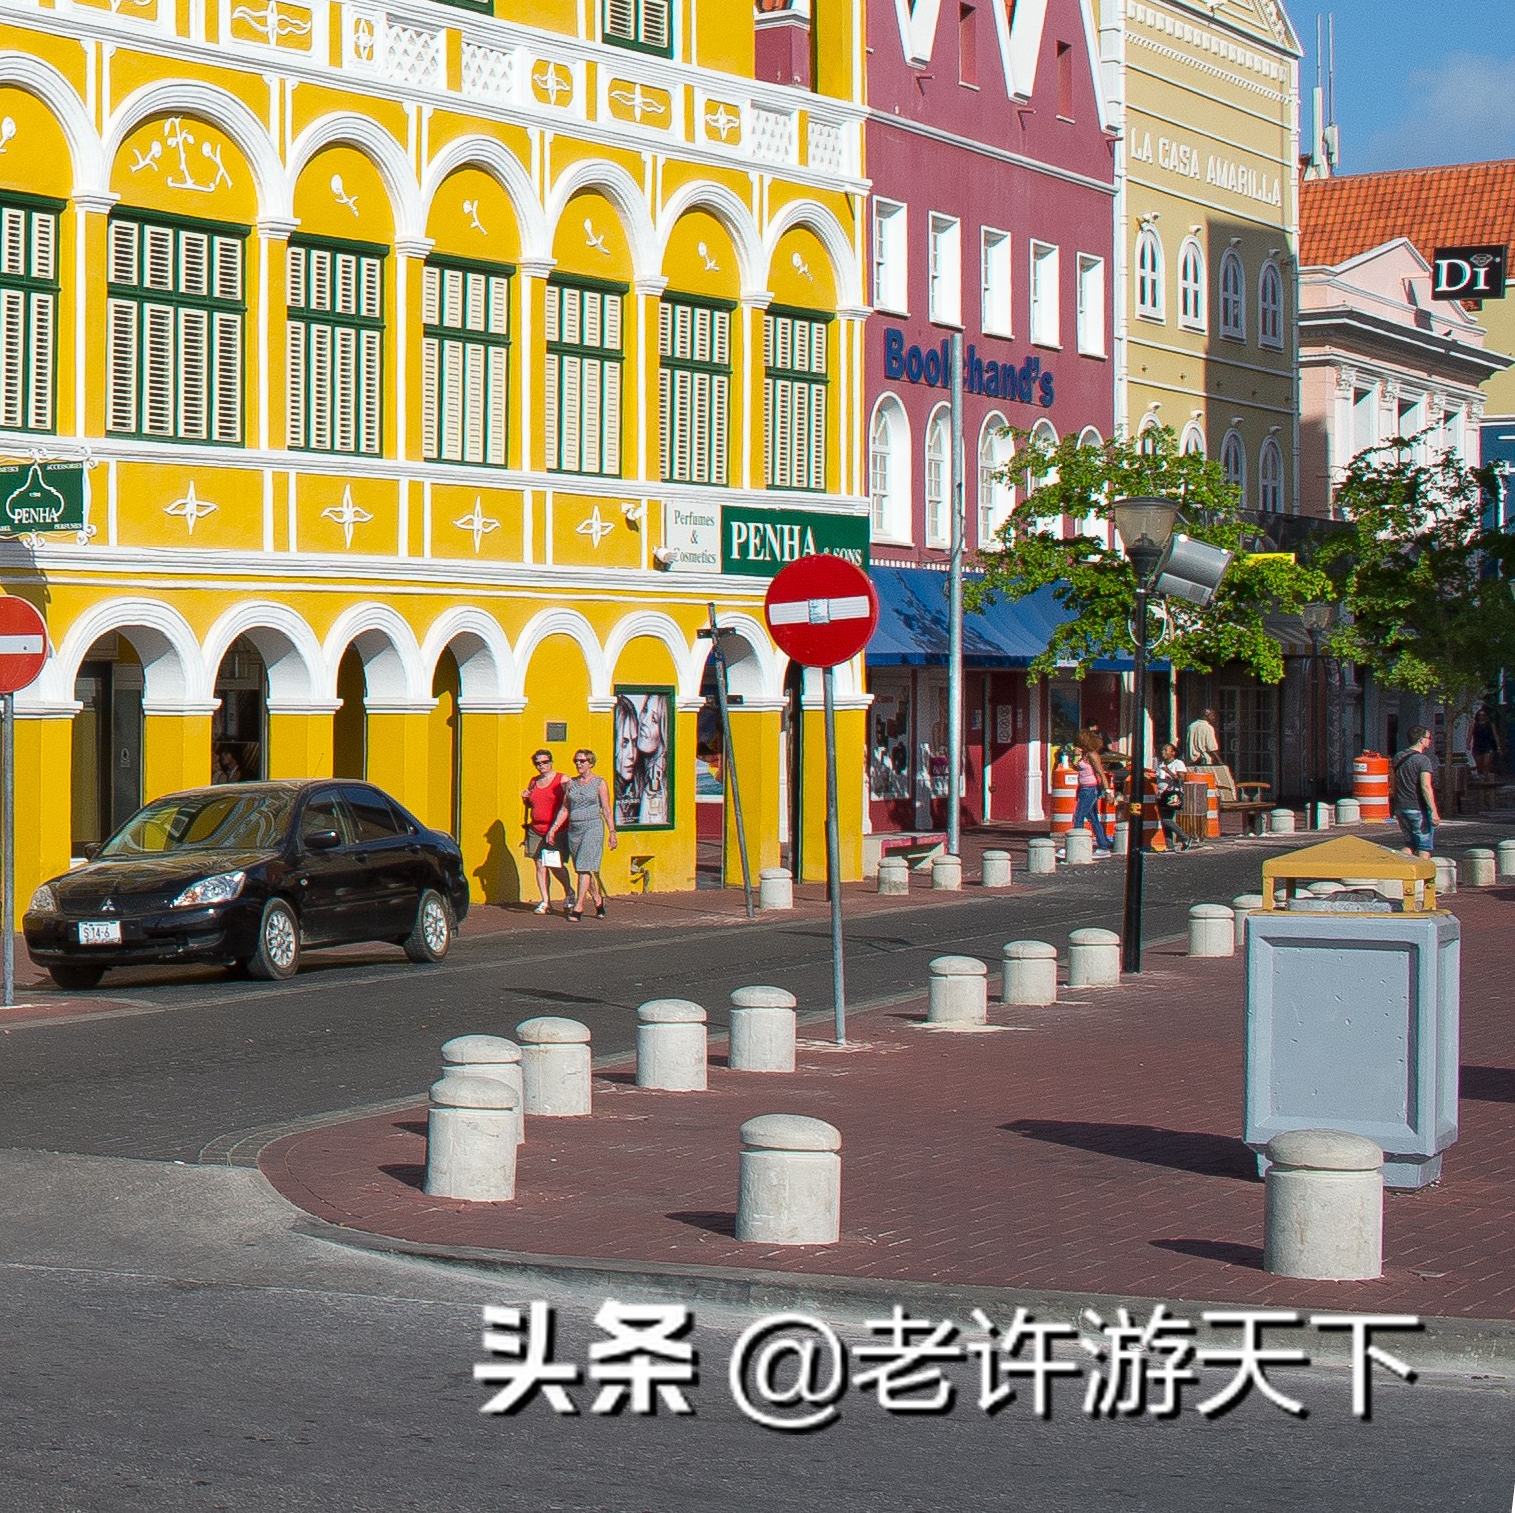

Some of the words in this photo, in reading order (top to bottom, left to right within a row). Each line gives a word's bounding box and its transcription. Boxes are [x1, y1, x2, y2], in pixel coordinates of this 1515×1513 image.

[1130, 127, 1153, 164] LA
[1158, 137, 1200, 180] CASA
[1206, 154, 1282, 207] AMARILLA
[884, 327, 1054, 408] Boolhand's
[14, 507, 59, 524] PENHA
[674, 509, 715, 526] Perfumes
[690, 530, 699, 545] &
[730, 521, 817, 563] PENHA
[673, 548, 717, 565] Cosmetics
